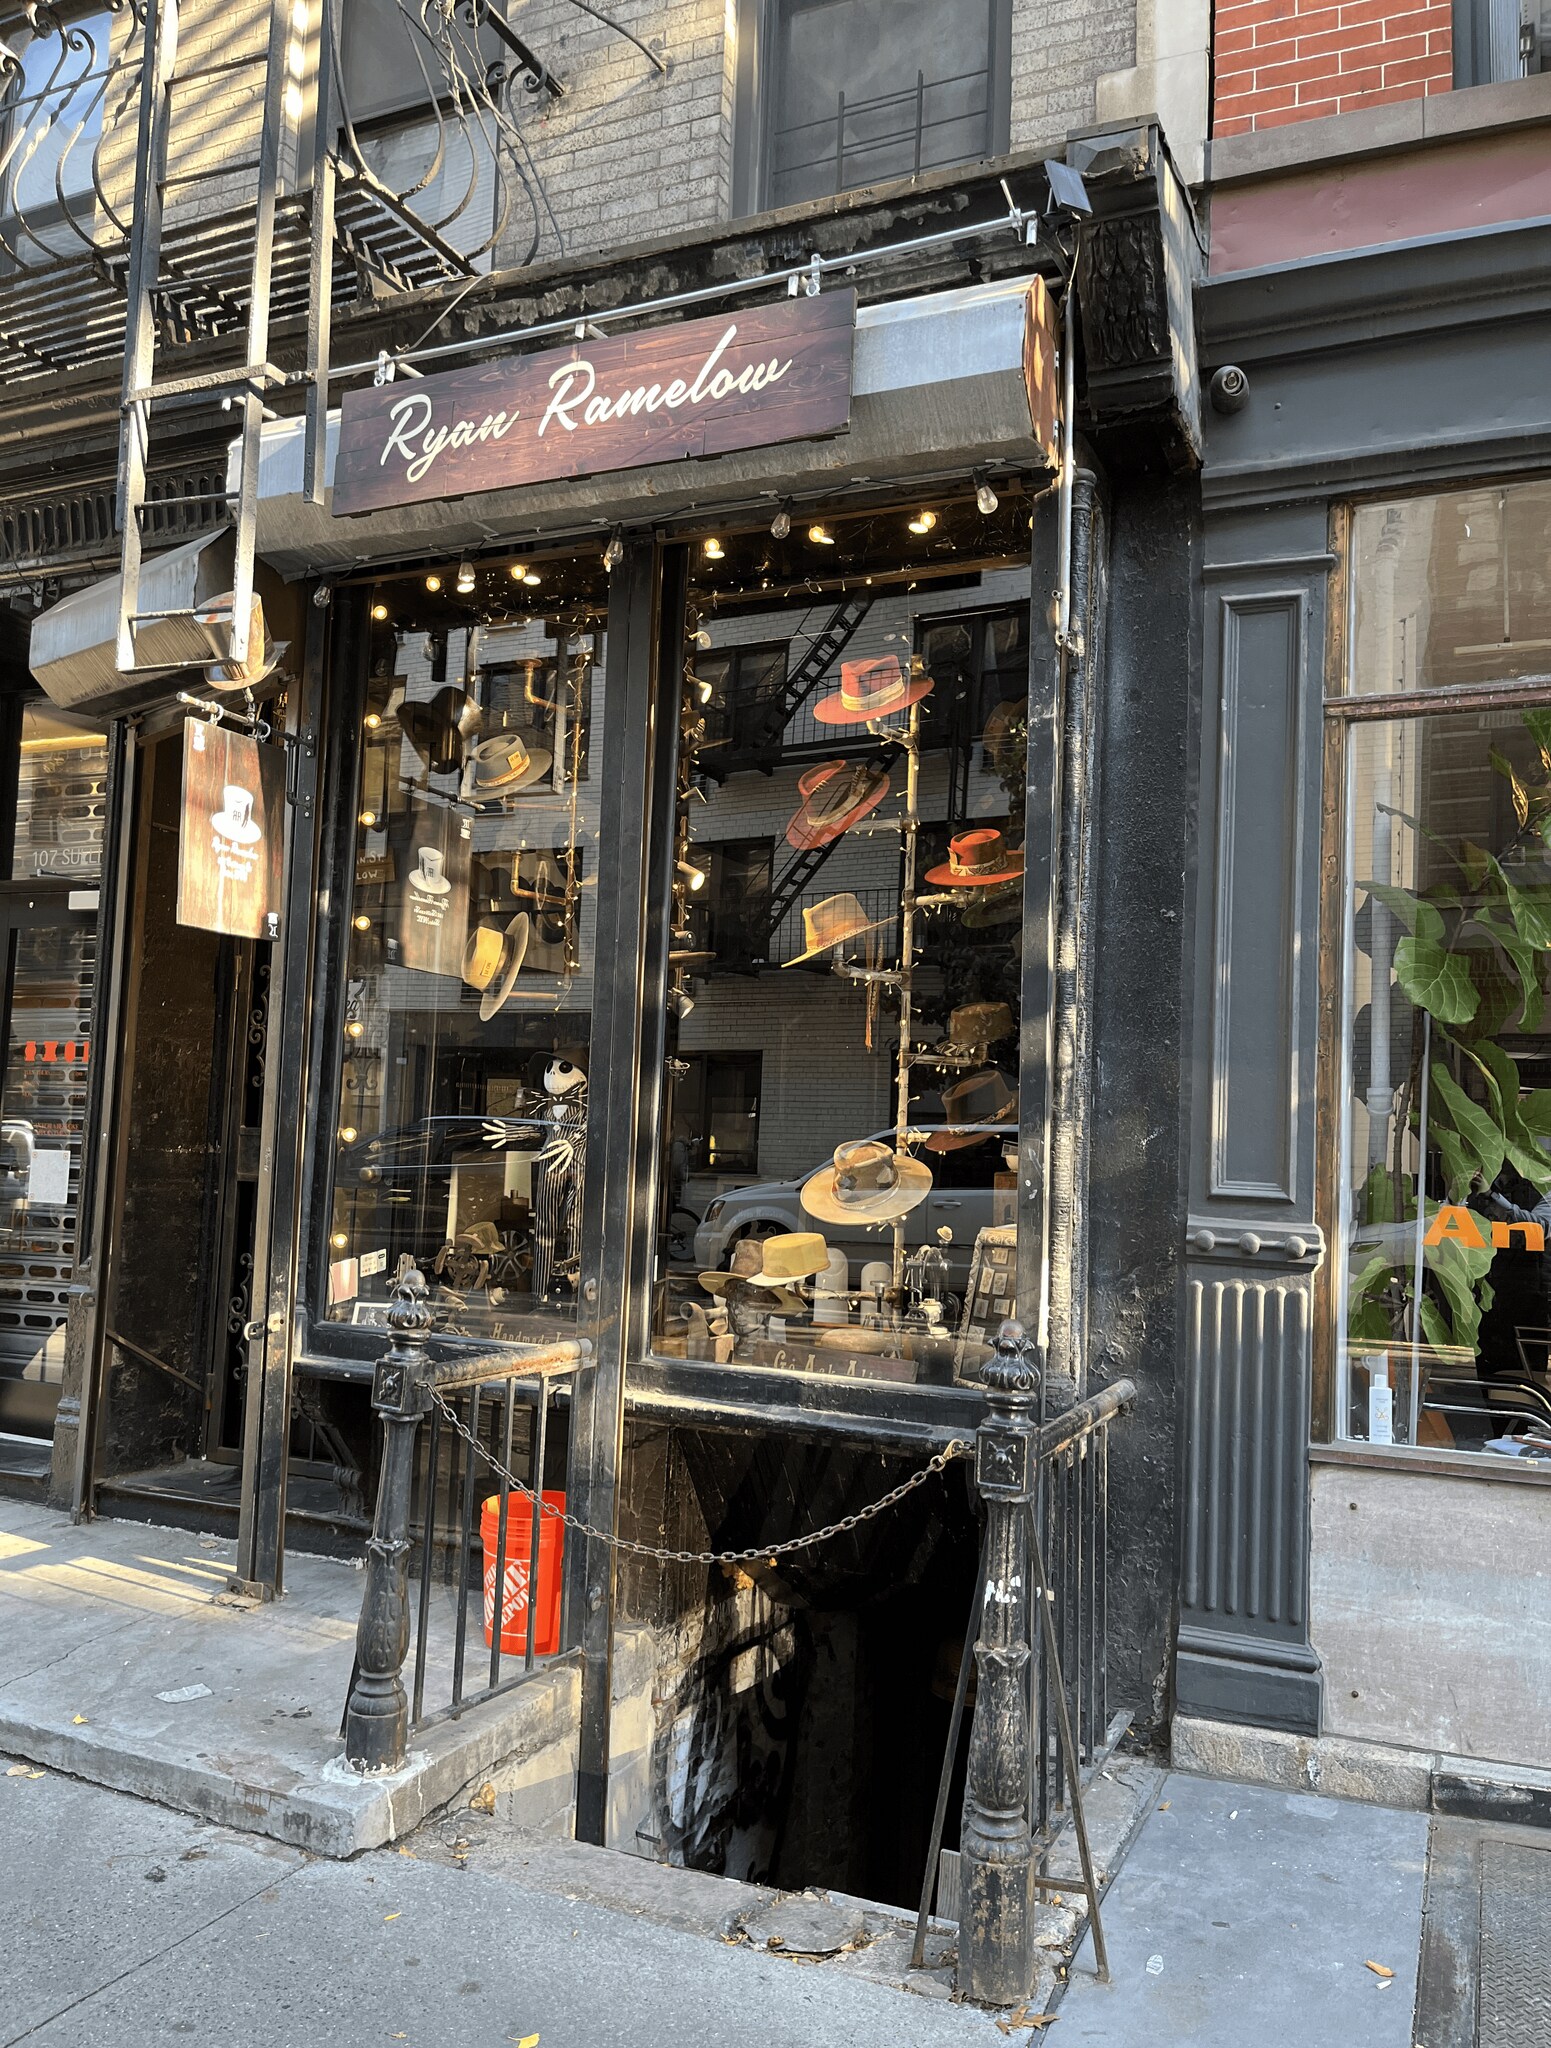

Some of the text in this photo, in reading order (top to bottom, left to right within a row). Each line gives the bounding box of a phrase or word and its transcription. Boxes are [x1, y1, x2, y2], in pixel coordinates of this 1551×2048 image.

[381, 324, 793, 483] Ryan Ramelow
[32, 850, 58, 867] 107
[1422, 1205, 1546, 1252] An
[804, 1353, 835, 1375] Ak
